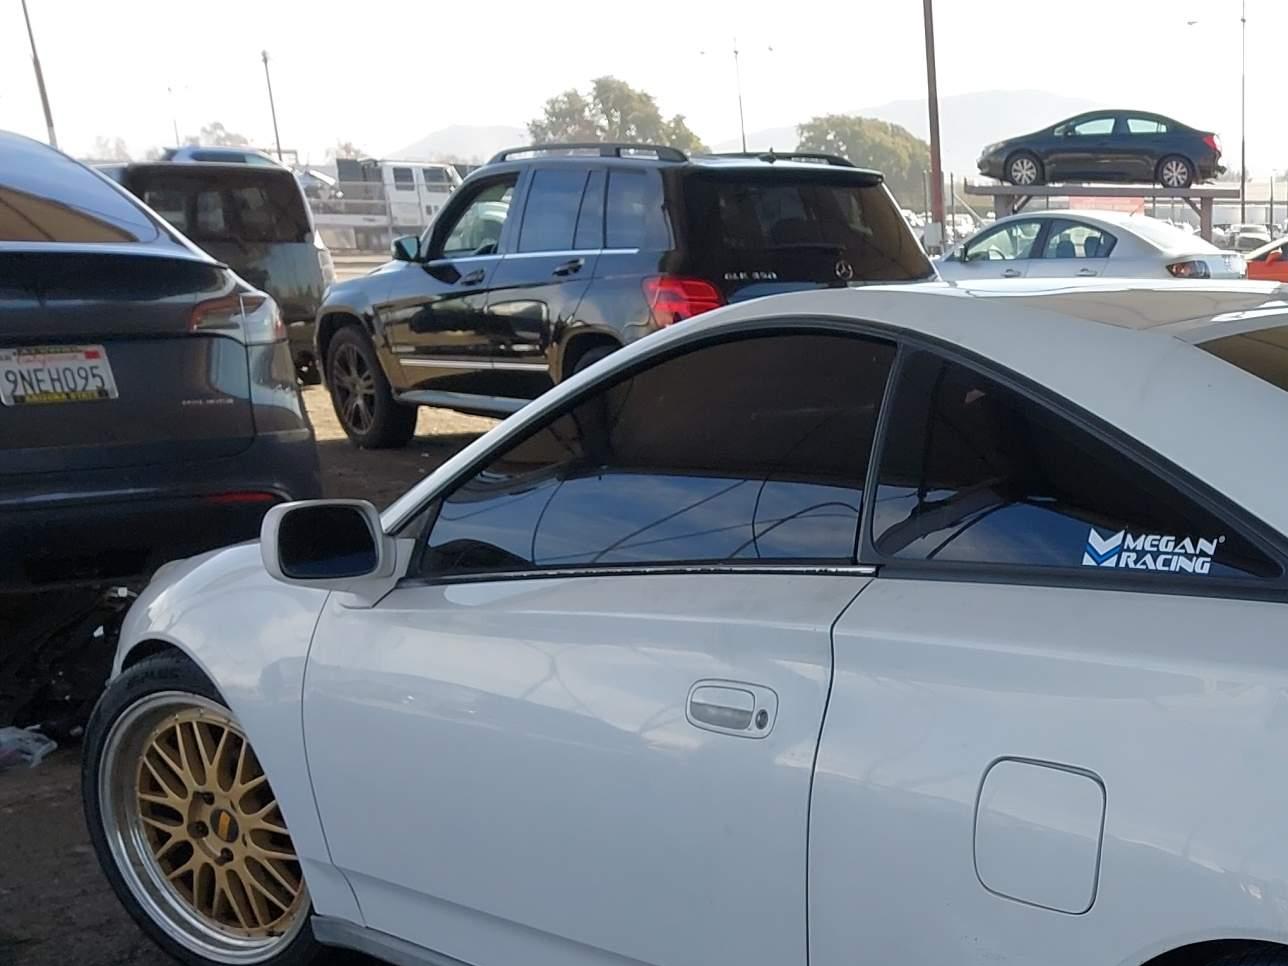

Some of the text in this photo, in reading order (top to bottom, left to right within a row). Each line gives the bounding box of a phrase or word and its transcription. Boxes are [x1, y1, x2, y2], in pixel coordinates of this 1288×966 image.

[5, 366, 105, 396] 9NEH095
[1124, 533, 1217, 555] MEGAN
[1119, 552, 1211, 574] RACING
